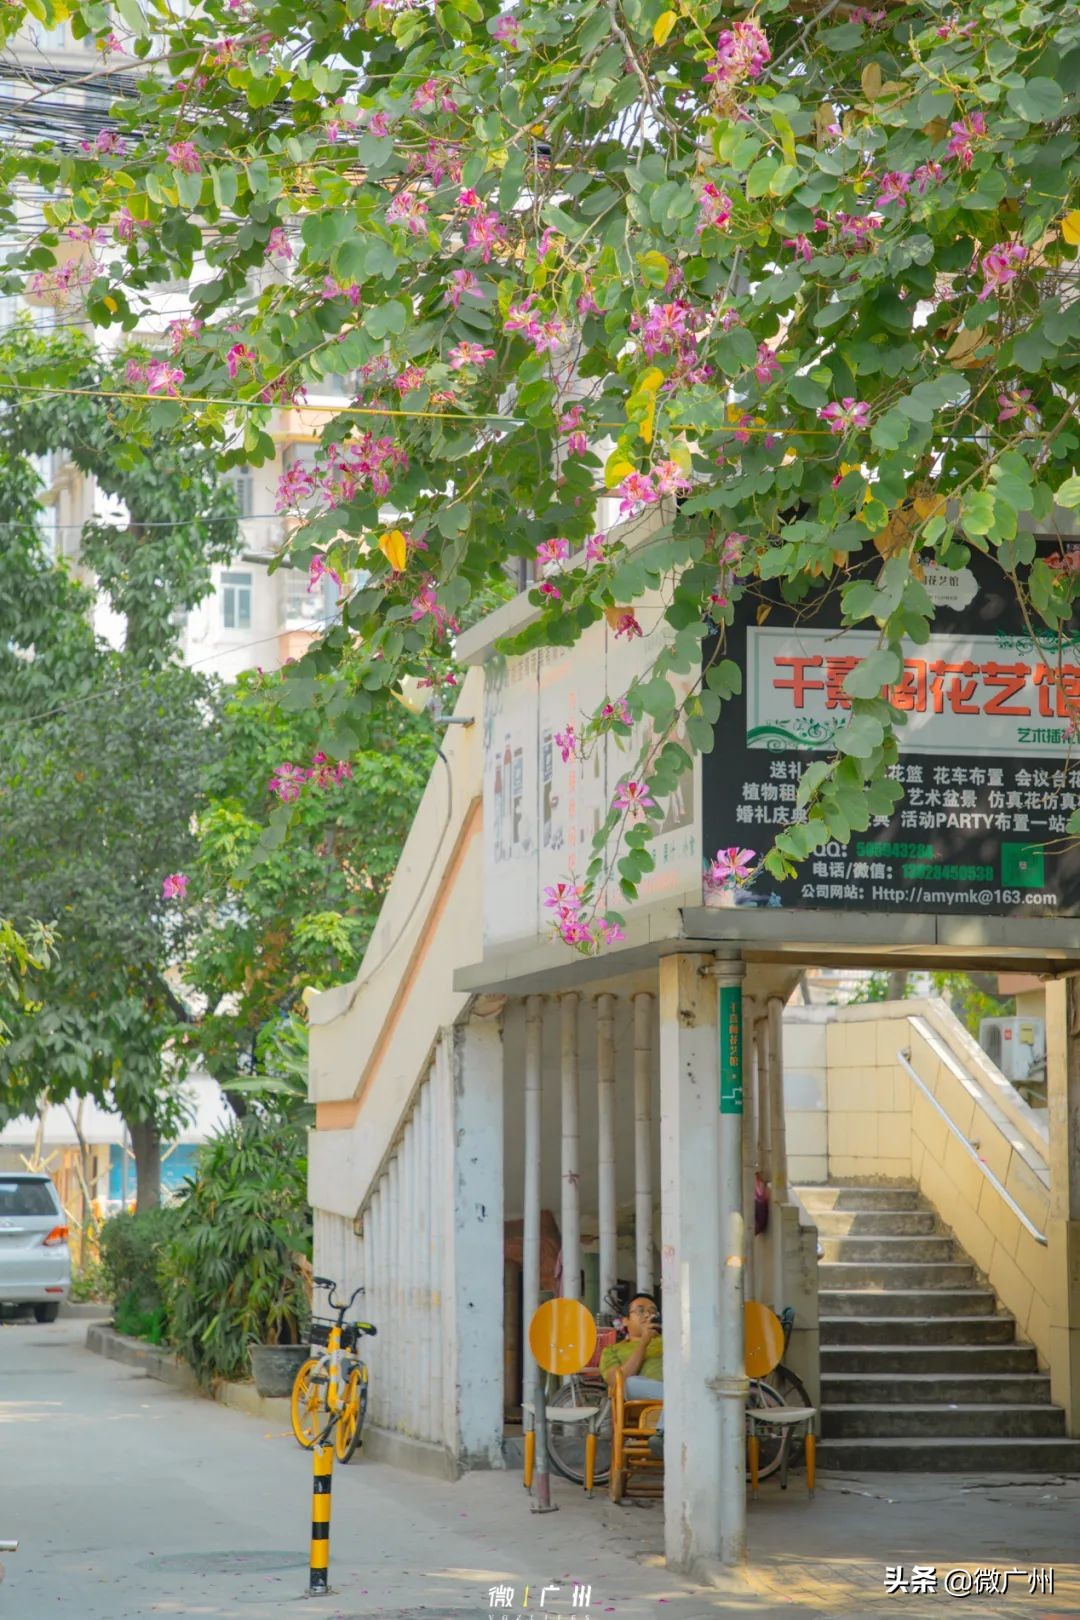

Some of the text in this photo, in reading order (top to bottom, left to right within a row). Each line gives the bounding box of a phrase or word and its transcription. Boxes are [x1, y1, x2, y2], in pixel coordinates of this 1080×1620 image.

[924, 575, 959, 587] 花艺馆
[1017, 728, 1080, 745] 艺术插花
[884, 764, 923, 783] 花篮
[933, 766, 1004, 787] 花车布置
[907, 788, 977, 808] 艺术盆景
[736, 805, 808, 824] 婚礼庆典
[901, 810, 1073, 833] 活动PARTY布置一站
[872, 886, 1057, 905] Http://amymk@163.com
